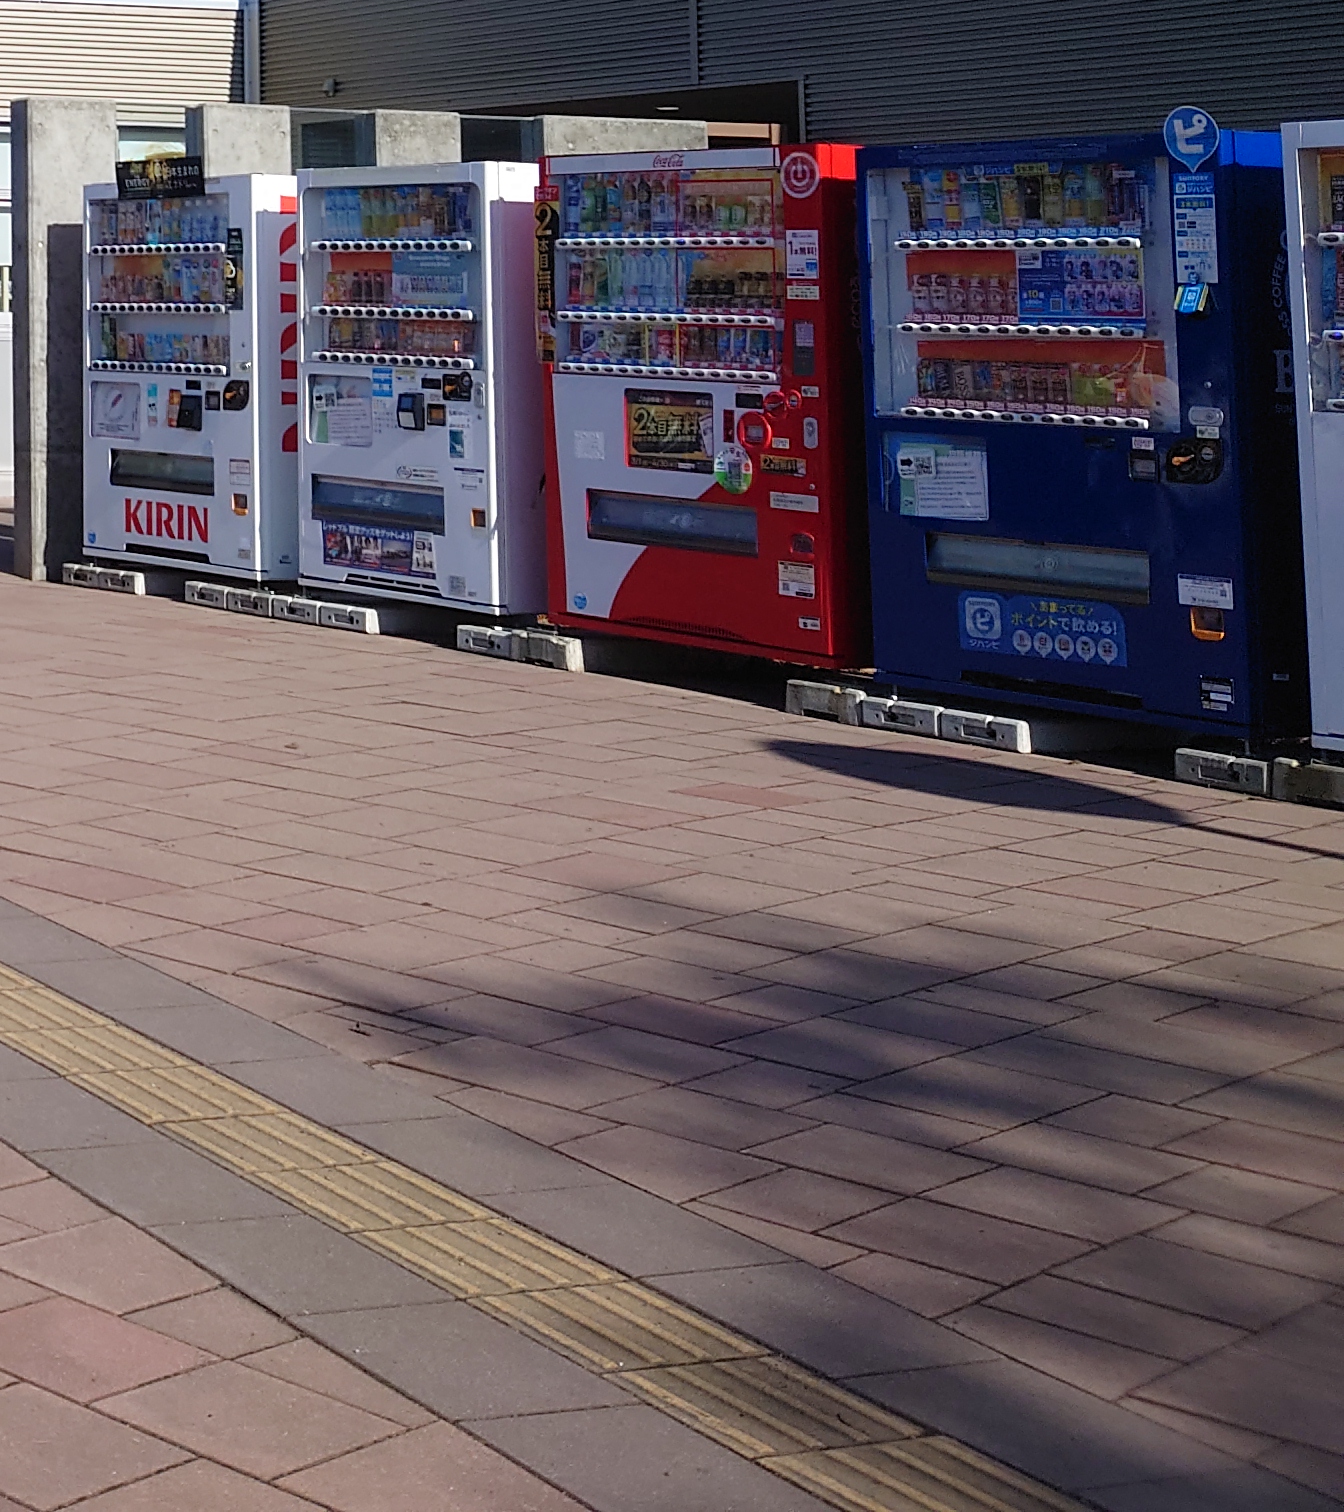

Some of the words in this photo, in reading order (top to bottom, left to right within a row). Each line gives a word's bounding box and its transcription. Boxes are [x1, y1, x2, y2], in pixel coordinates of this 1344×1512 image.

[1173, 113, 1208, 155] ピ
[633, 407, 700, 438] 2本目無料
[124, 497, 209, 544] KIRIN
[1011, 612, 1118, 636] ポイントで飲める!
[968, 639, 1000, 650] ジハンピ
